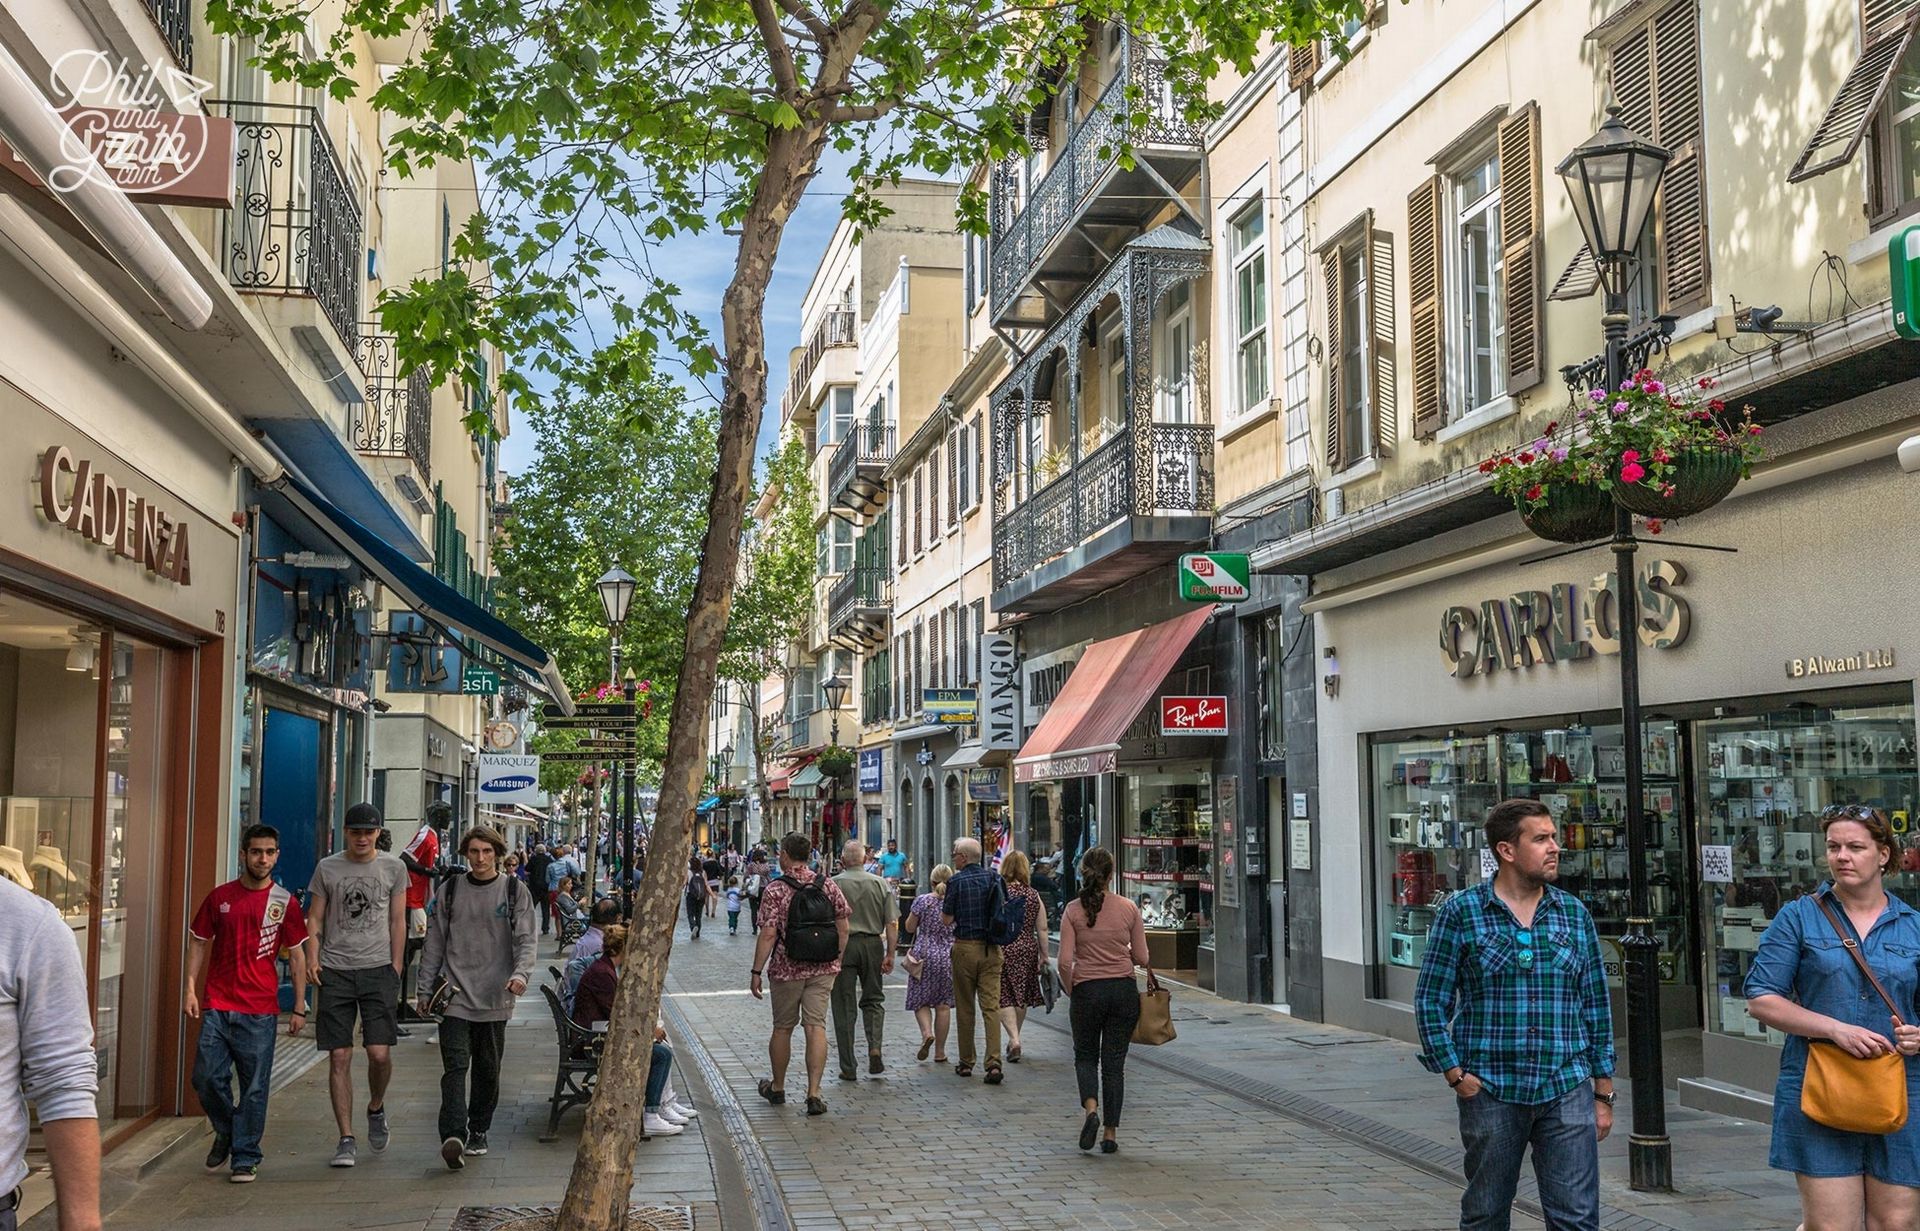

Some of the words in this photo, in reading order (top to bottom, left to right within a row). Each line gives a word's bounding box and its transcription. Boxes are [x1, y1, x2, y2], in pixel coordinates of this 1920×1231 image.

[41, 446, 191, 586] CADENZA
[1191, 585, 1243, 596] FUJIFILM
[1439, 559, 1691, 679] CARLOS
[1807, 651, 1863, 676] Alwani
[1866, 648, 1894, 669] Ltd
[463, 675, 493, 691] ash
[937, 692, 961, 701] EPM
[989, 640, 1014, 743] MANGO
[482, 756, 537, 767] MARQUEZ
[487, 779, 530, 789] SAMSUNG
